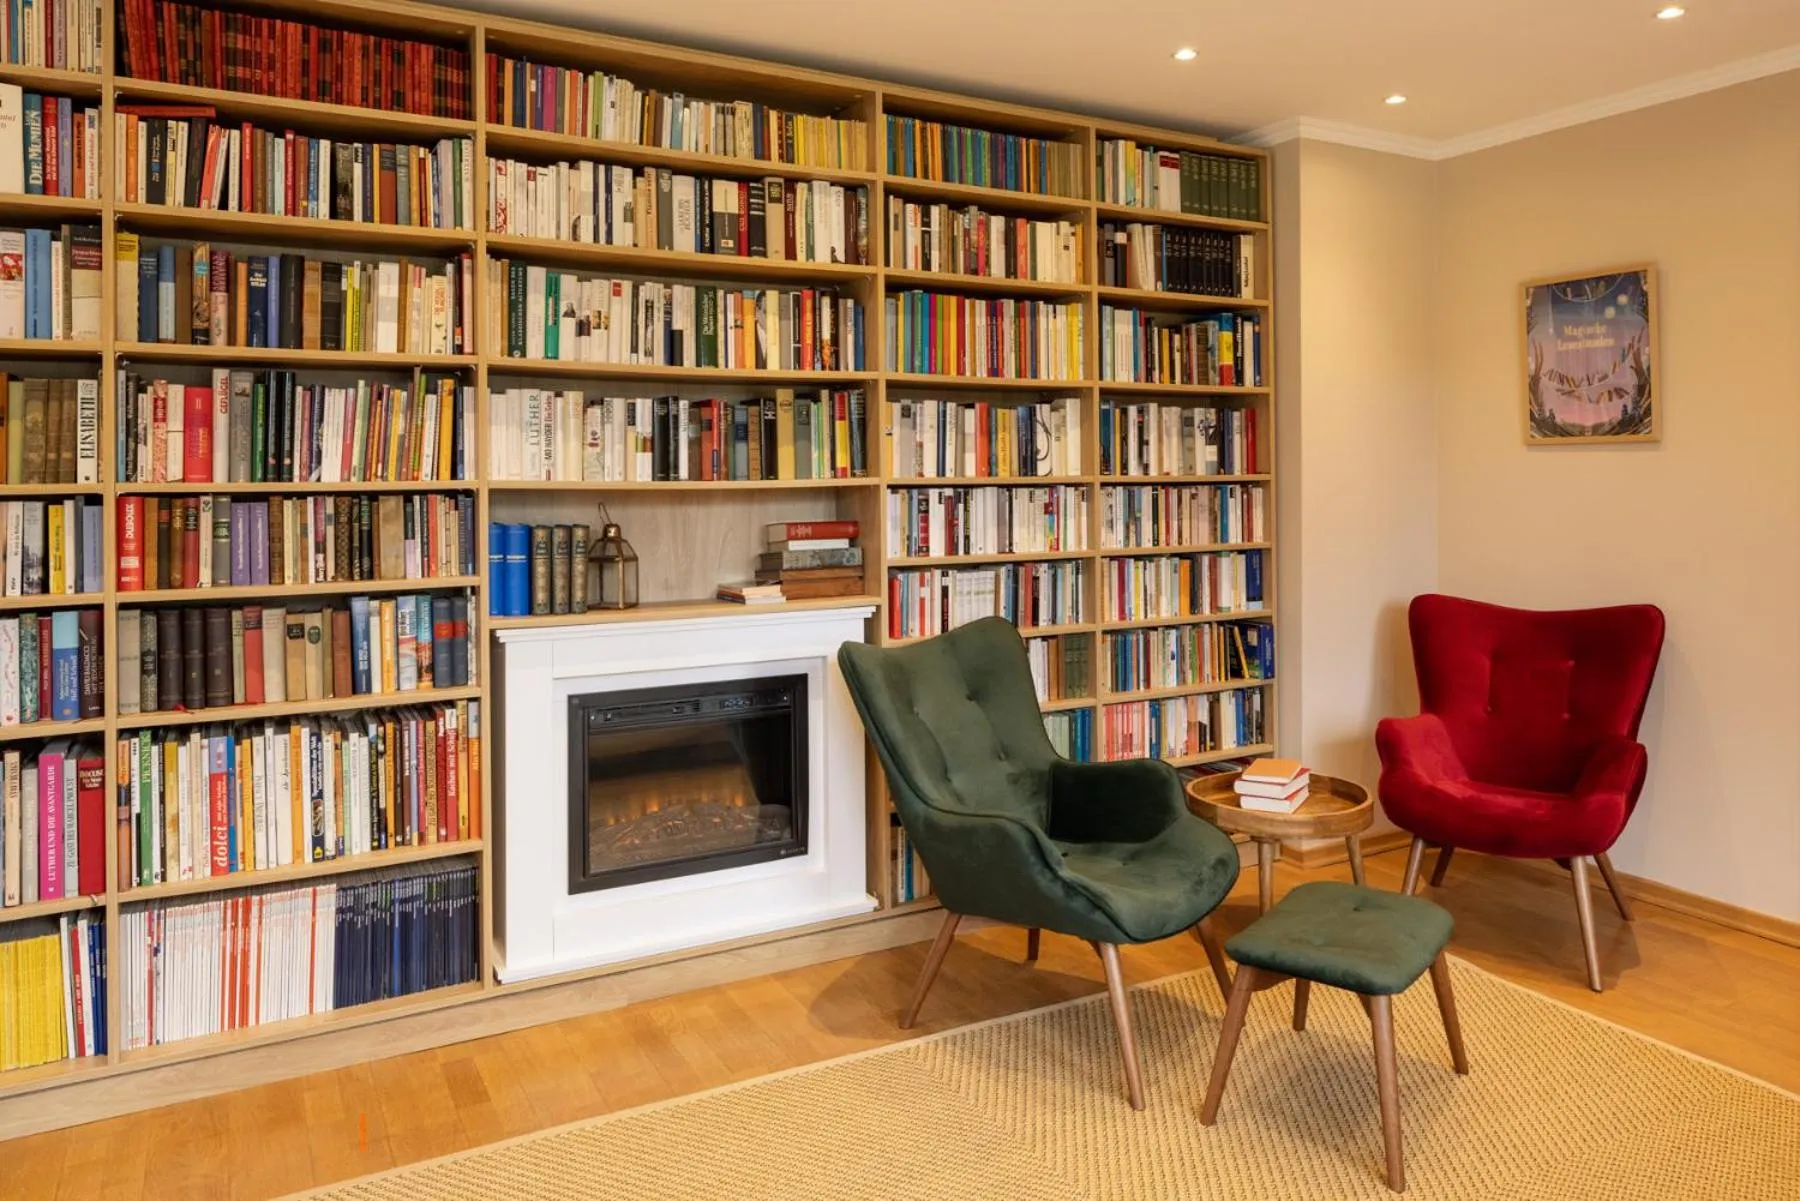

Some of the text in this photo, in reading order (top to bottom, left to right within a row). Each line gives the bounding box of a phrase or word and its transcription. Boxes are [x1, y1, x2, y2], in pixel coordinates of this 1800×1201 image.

[29, 161, 43, 185] DIE
[218, 376, 229, 414] GEFLÜGEL
[80, 397, 95, 459] ELISABETH
[529, 394, 540, 446] LUTHER
[544, 423, 552, 448] HAYDER
[141, 733, 152, 783] PICKNICK
[66, 778, 74, 802] PROUST
[447, 769, 456, 797] Kochen
[47, 765, 56, 882] LUTHER UND DIE AVANTGARDE
[66, 803, 74, 829] MARCEL
[213, 826, 227, 867] dolci
